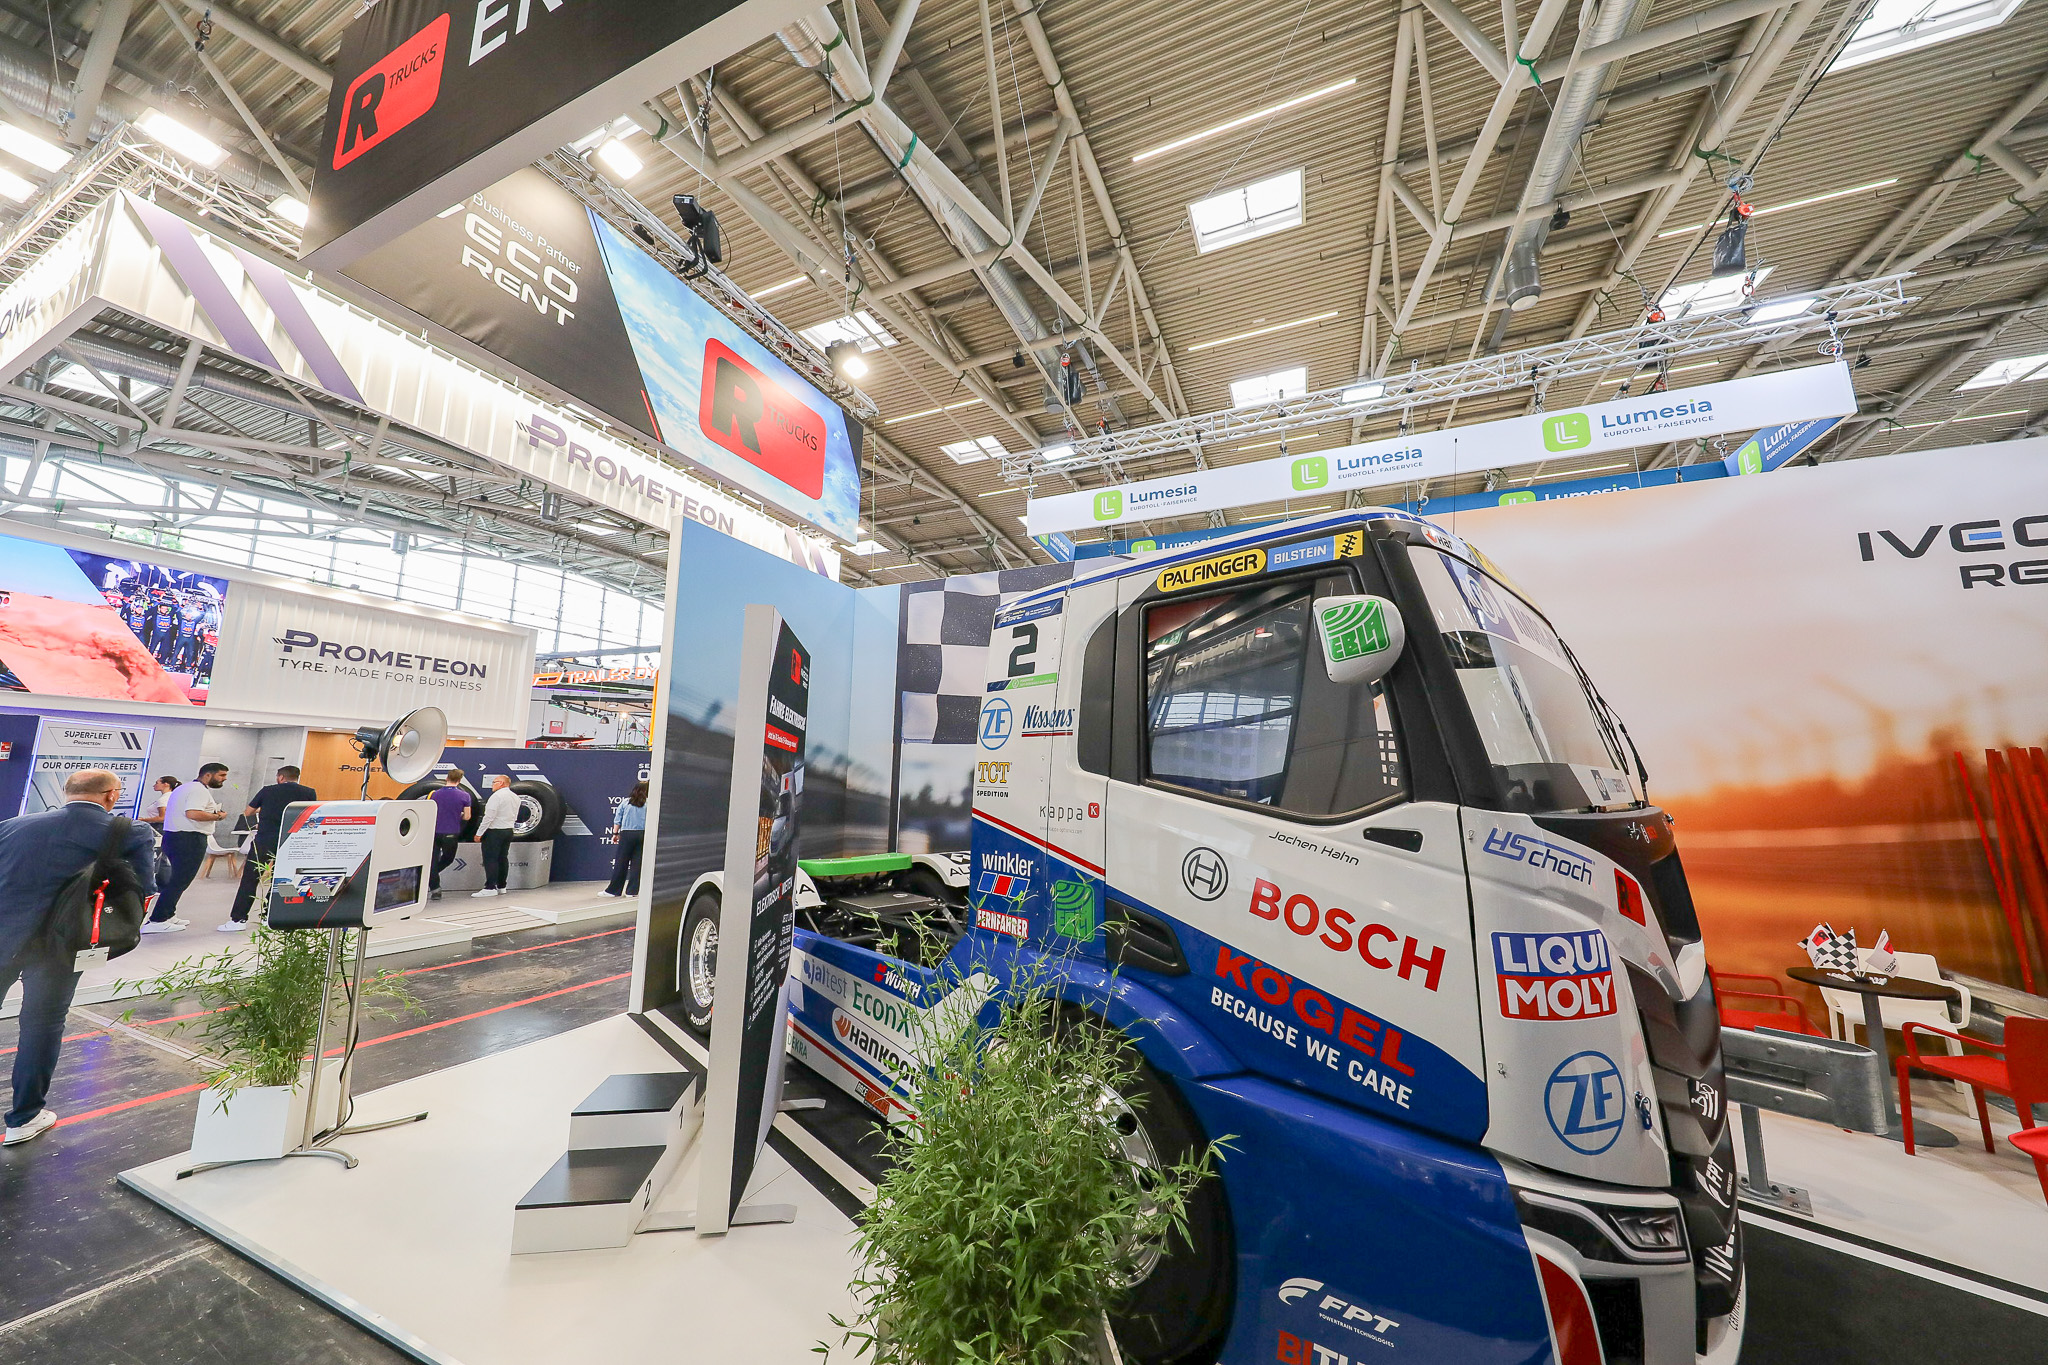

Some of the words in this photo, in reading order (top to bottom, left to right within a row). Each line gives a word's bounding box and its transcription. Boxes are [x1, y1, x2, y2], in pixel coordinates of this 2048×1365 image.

[389, 43, 437, 88] TRUCKS
[342, 73, 385, 155] R
[474, 193, 533, 242] Business
[537, 236, 581, 274] Partner
[461, 245, 575, 326] RENT
[712, 357, 764, 455] R
[1601, 399, 1713, 429] Lumesia
[768, 405, 817, 451] TRUCKS
[527, 414, 734, 535] PROMETEON
[1337, 446, 1423, 471] Lumesia
[1130, 483, 1197, 504] Lumesia
[1163, 553, 1257, 587] PALFINGER
[1274, 545, 1327, 564] BILSTEIN
[281, 629, 487, 679] PROMETEON
[1008, 623, 1038, 677] 2
[1332, 620, 1381, 659] EBLA
[279, 658, 328, 672] TYRE.
[335, 666, 380, 679] MADE
[385, 672, 413, 683] FOR
[419, 676, 482, 691] BUSINESS
[565, 668, 631, 684] TRAILER
[981, 706, 1012, 741] ZF
[1023, 705, 1074, 729] Nissens
[64, 730, 112, 740] SUPERFLEET
[42, 761, 61, 769] OUR
[64, 762, 91, 770] OFFER
[111, 763, 137, 771] FLEETS
[978, 762, 1010, 783] TCT
[977, 790, 1008, 798] SPEDITION
[1040, 805, 1083, 822] kappa
[982, 851, 1034, 877] winkler
[1269, 831, 1318, 853] Jochen
[1320, 845, 1359, 866] Hahn
[977, 910, 1028, 938] FERNFAHRER
[1249, 877, 1446, 992] BOSCH
[1499, 933, 1608, 975] LIQUI
[1215, 946, 1415, 1077] KÖGEL
[1505, 974, 1611, 1017] MOLY
[1211, 986, 1299, 1048] BECAUSE
[1306, 1035, 1341, 1071] WE
[1348, 1060, 1412, 1109] CARE
[679, 1106, 684, 1129] 1
[1549, 1069, 1623, 1135] ZF
[1705, 1156, 1724, 1189] FPT
[643, 1179, 651, 1211] 2
[1319, 1295, 1400, 1334] FPT
[1319, 1312, 1353, 1331] POWERTRAIN
[1353, 1327, 1395, 1348] TECHNOLOGIES
